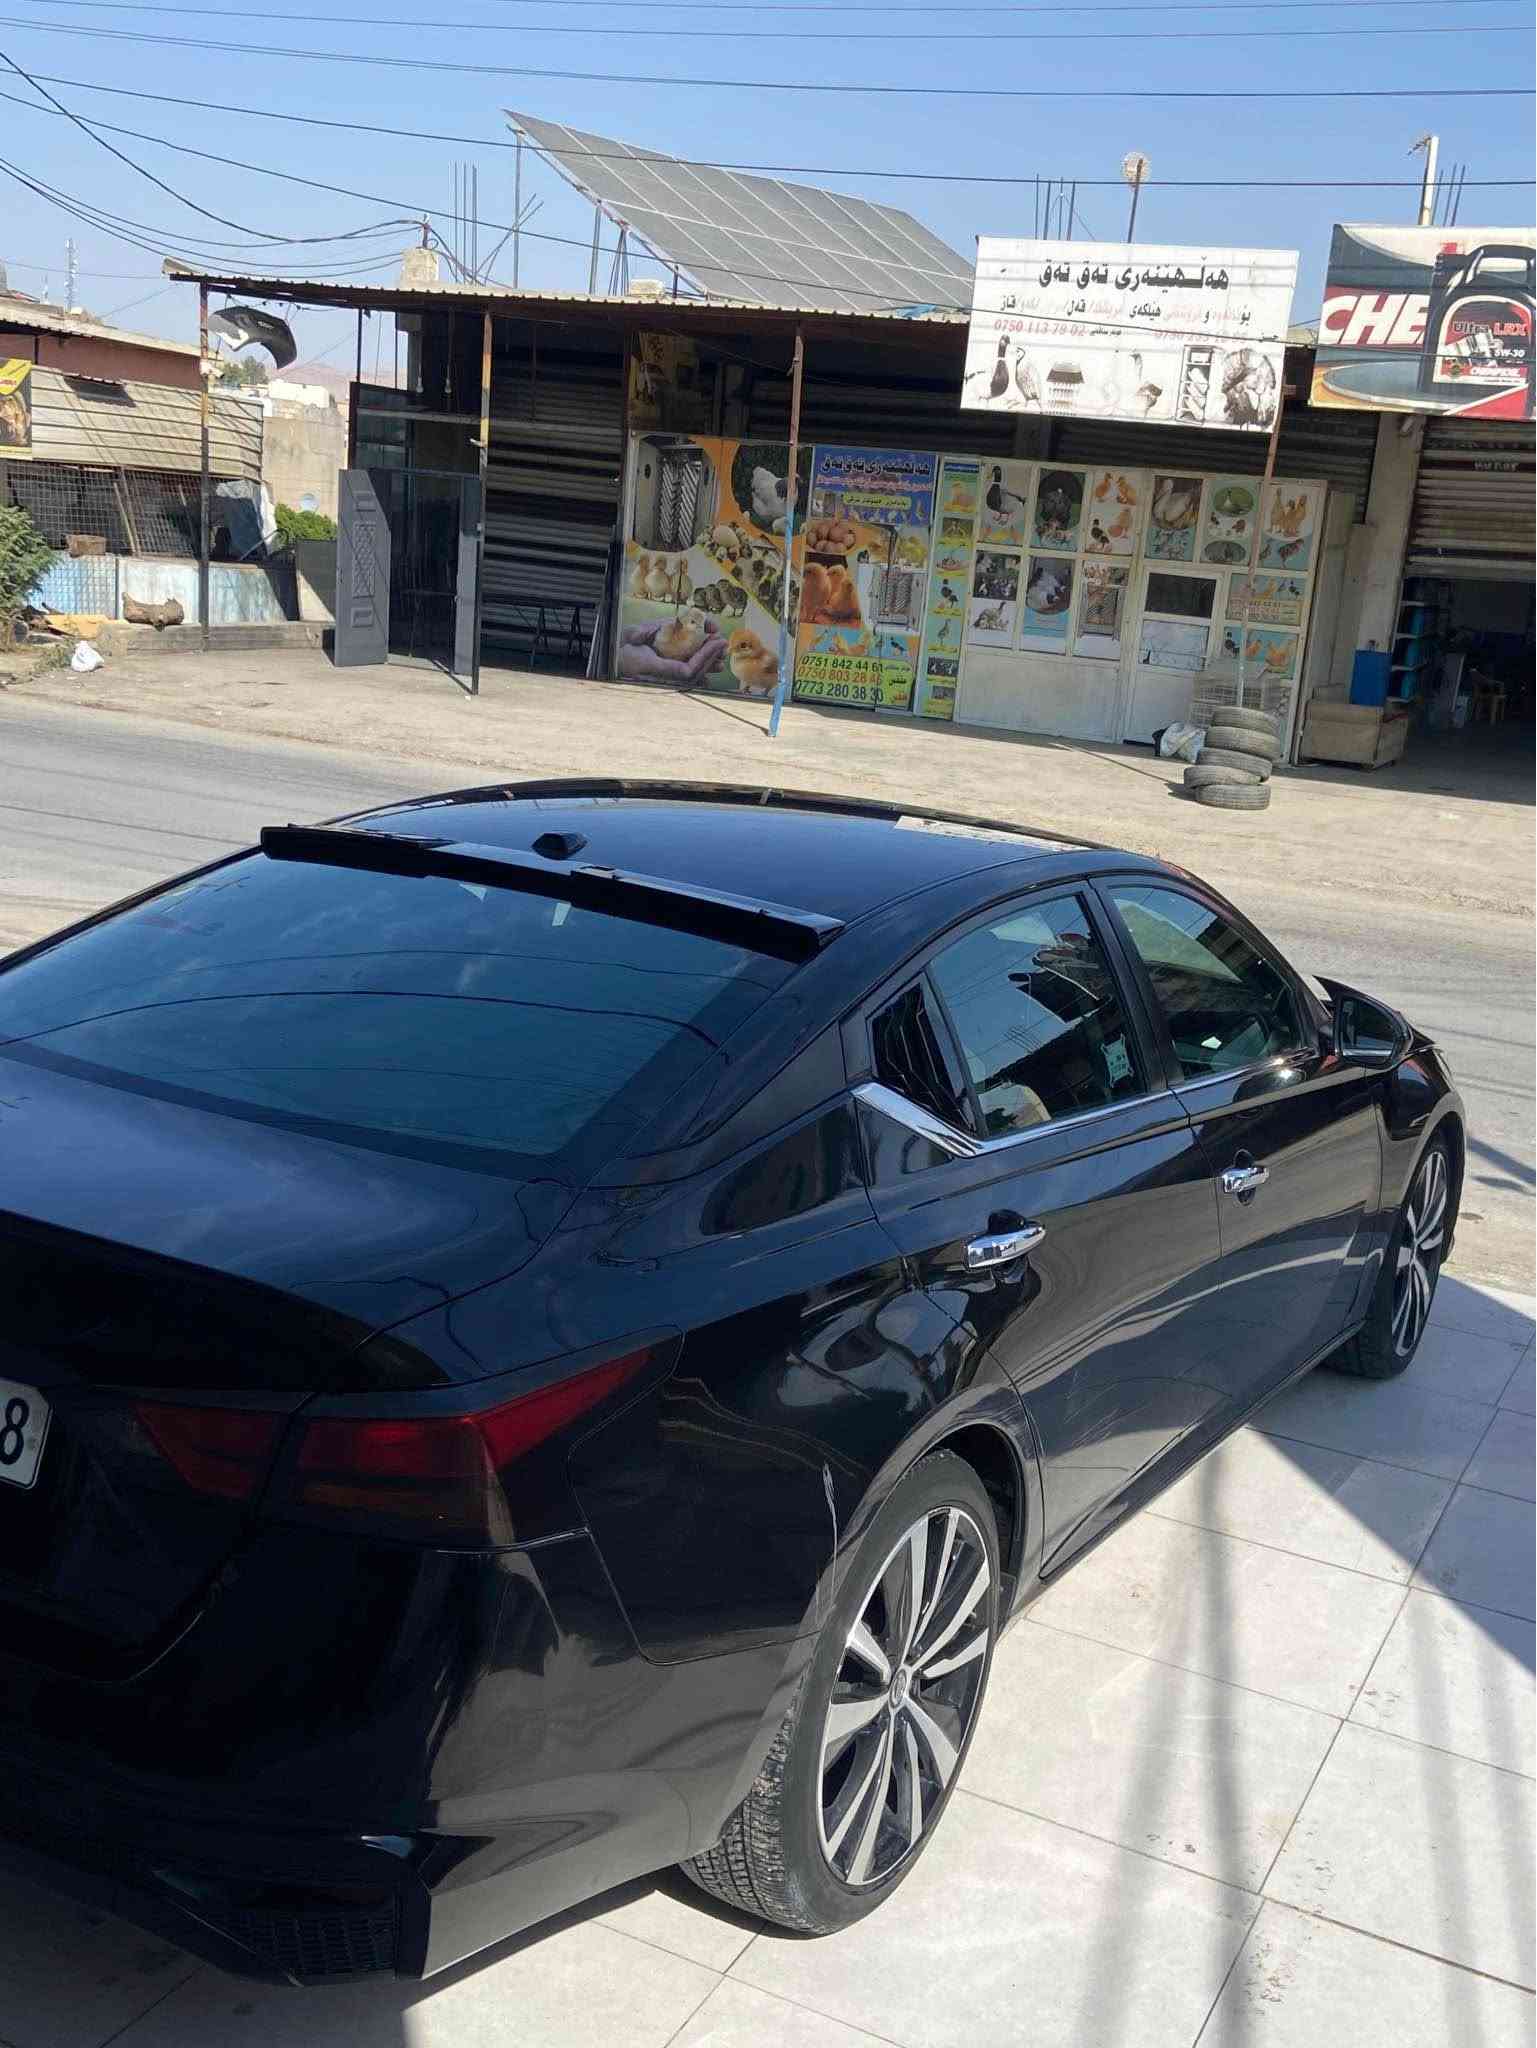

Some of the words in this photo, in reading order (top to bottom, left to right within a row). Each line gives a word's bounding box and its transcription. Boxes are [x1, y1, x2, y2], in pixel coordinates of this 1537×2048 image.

[1039, 258, 1070, 287] تەق
[1076, 260, 1109, 290] تەق
[801, 655, 828, 667] 0751
[831, 658, 853, 670] 842
[855, 661, 869, 671] 44
[826, 682, 849, 698] 280
[852, 686, 867, 701] 38
